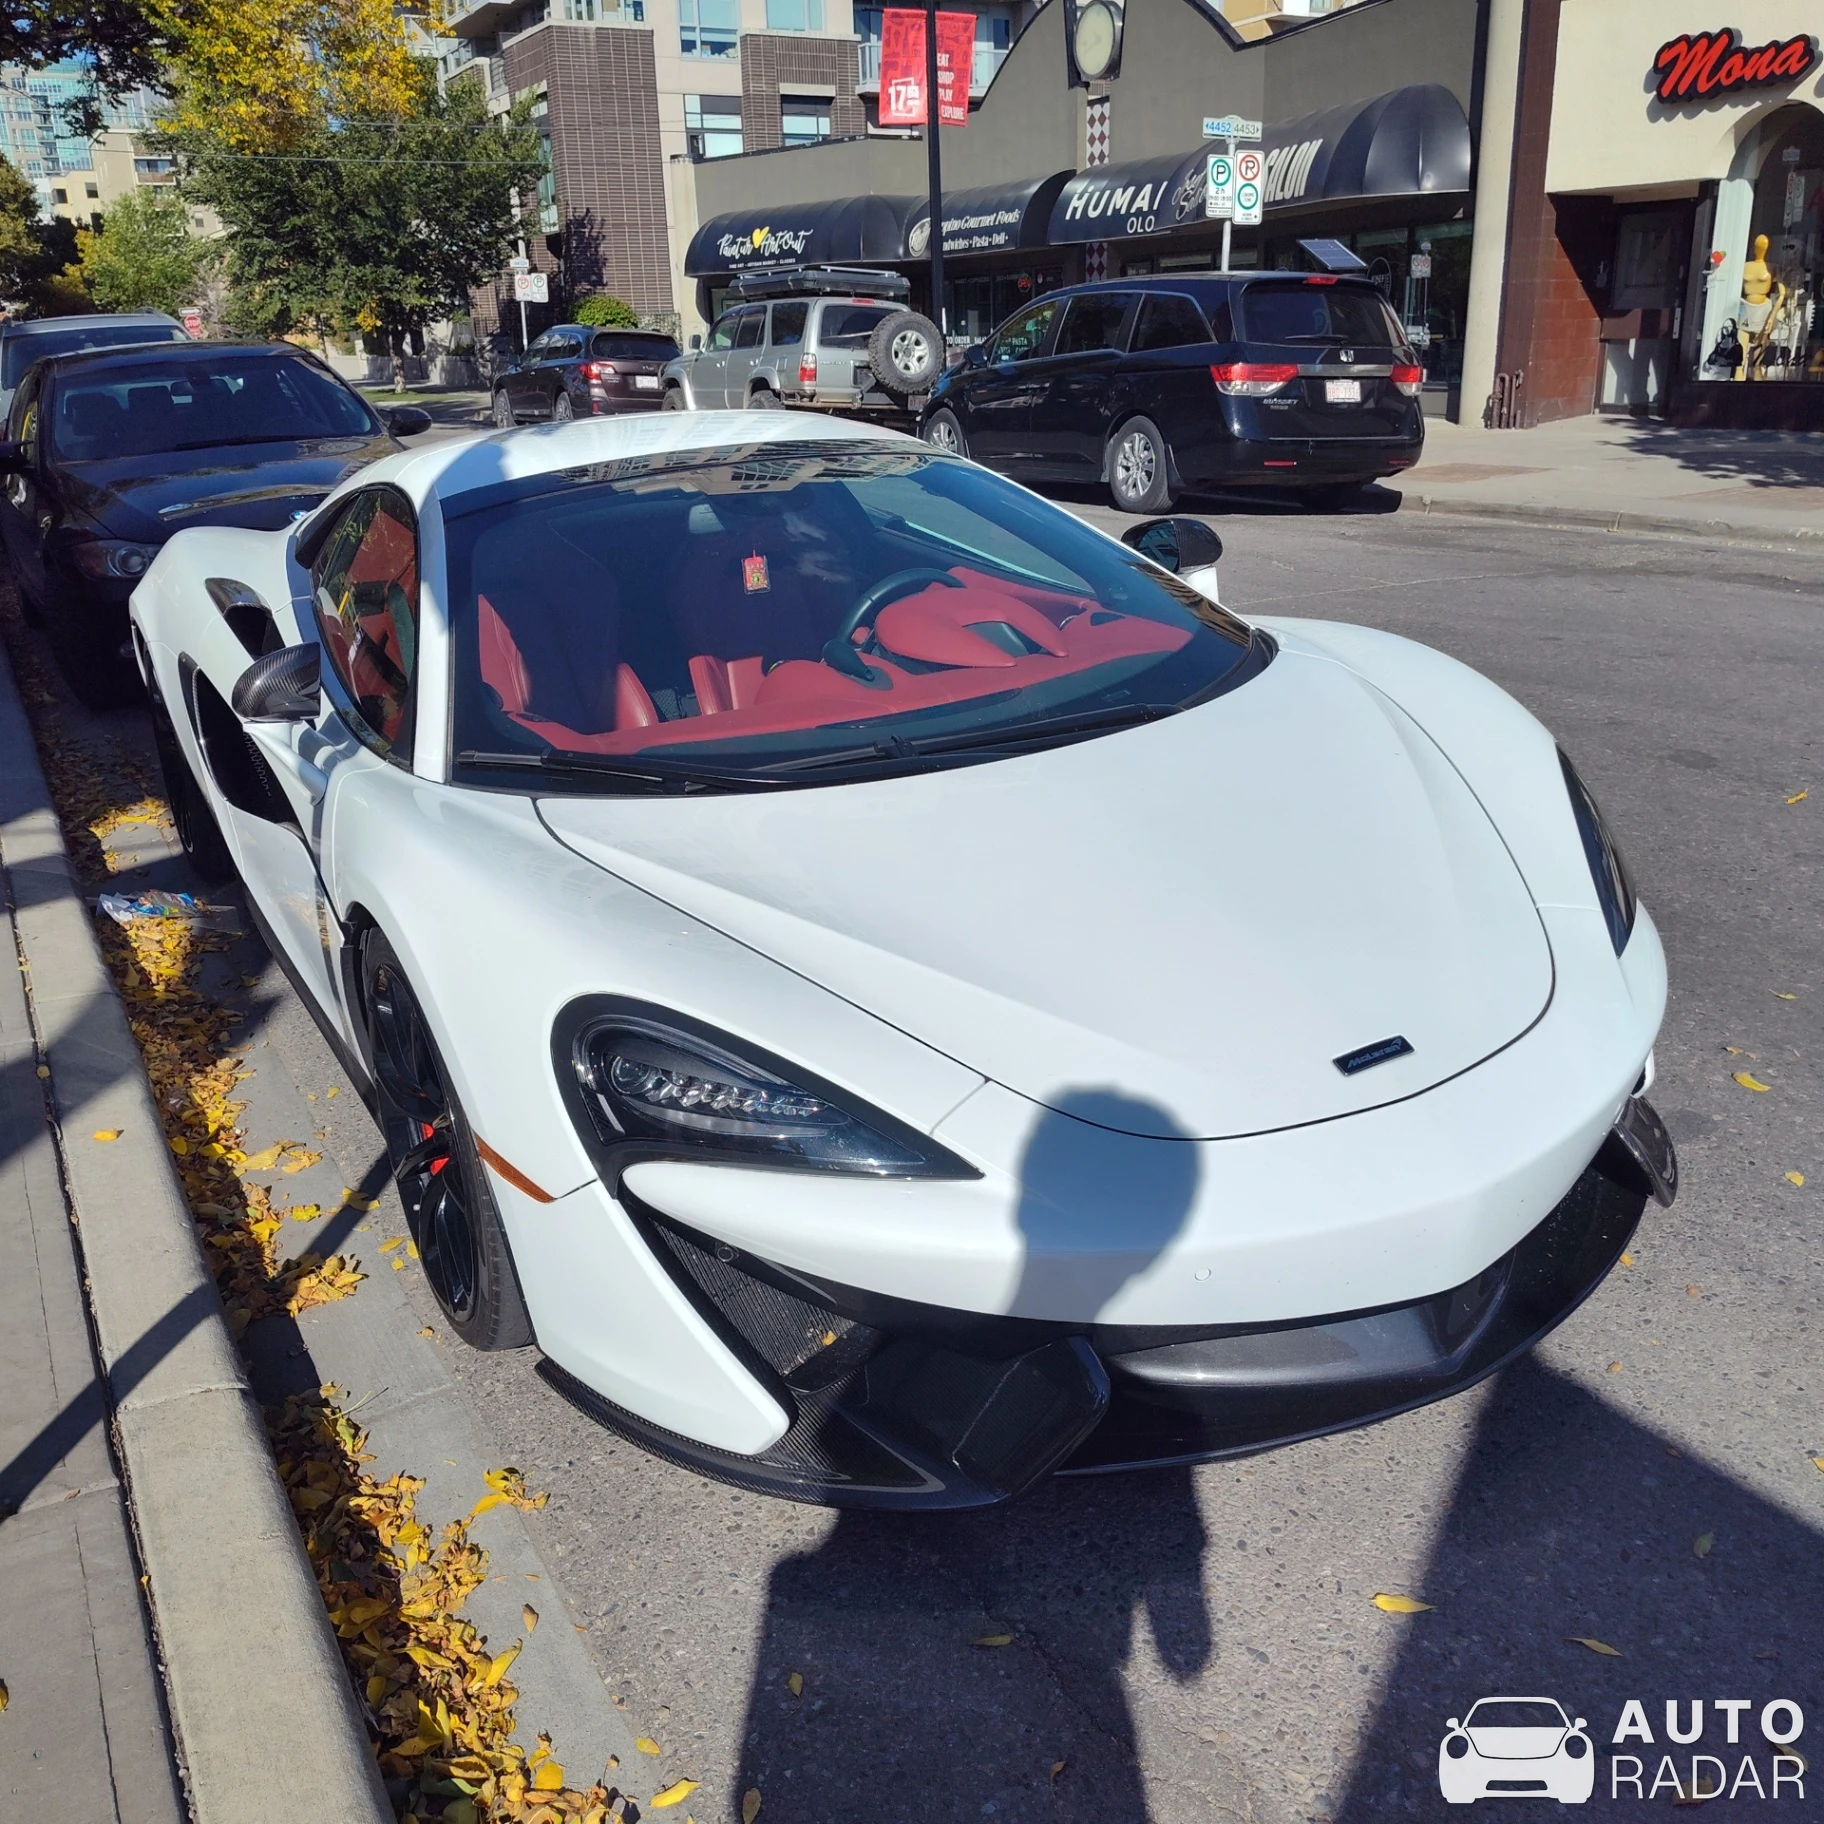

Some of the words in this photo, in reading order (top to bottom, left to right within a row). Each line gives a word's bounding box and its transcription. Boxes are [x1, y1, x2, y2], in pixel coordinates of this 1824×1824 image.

[937, 53, 949, 67] EAT
[1656, 31, 1811, 100] Mona
[938, 71, 954, 85] SHOP
[888, 85, 906, 110] 17
[1209, 122, 1231, 133] 4452
[1234, 123, 1256, 135] 4453
[1216, 165, 1226, 181] P
[962, 213, 996, 230] Gourmet
[996, 208, 1021, 226] Foods
[1127, 215, 1155, 234] OLO
[1348, 1043, 1401, 1069] McLaren
